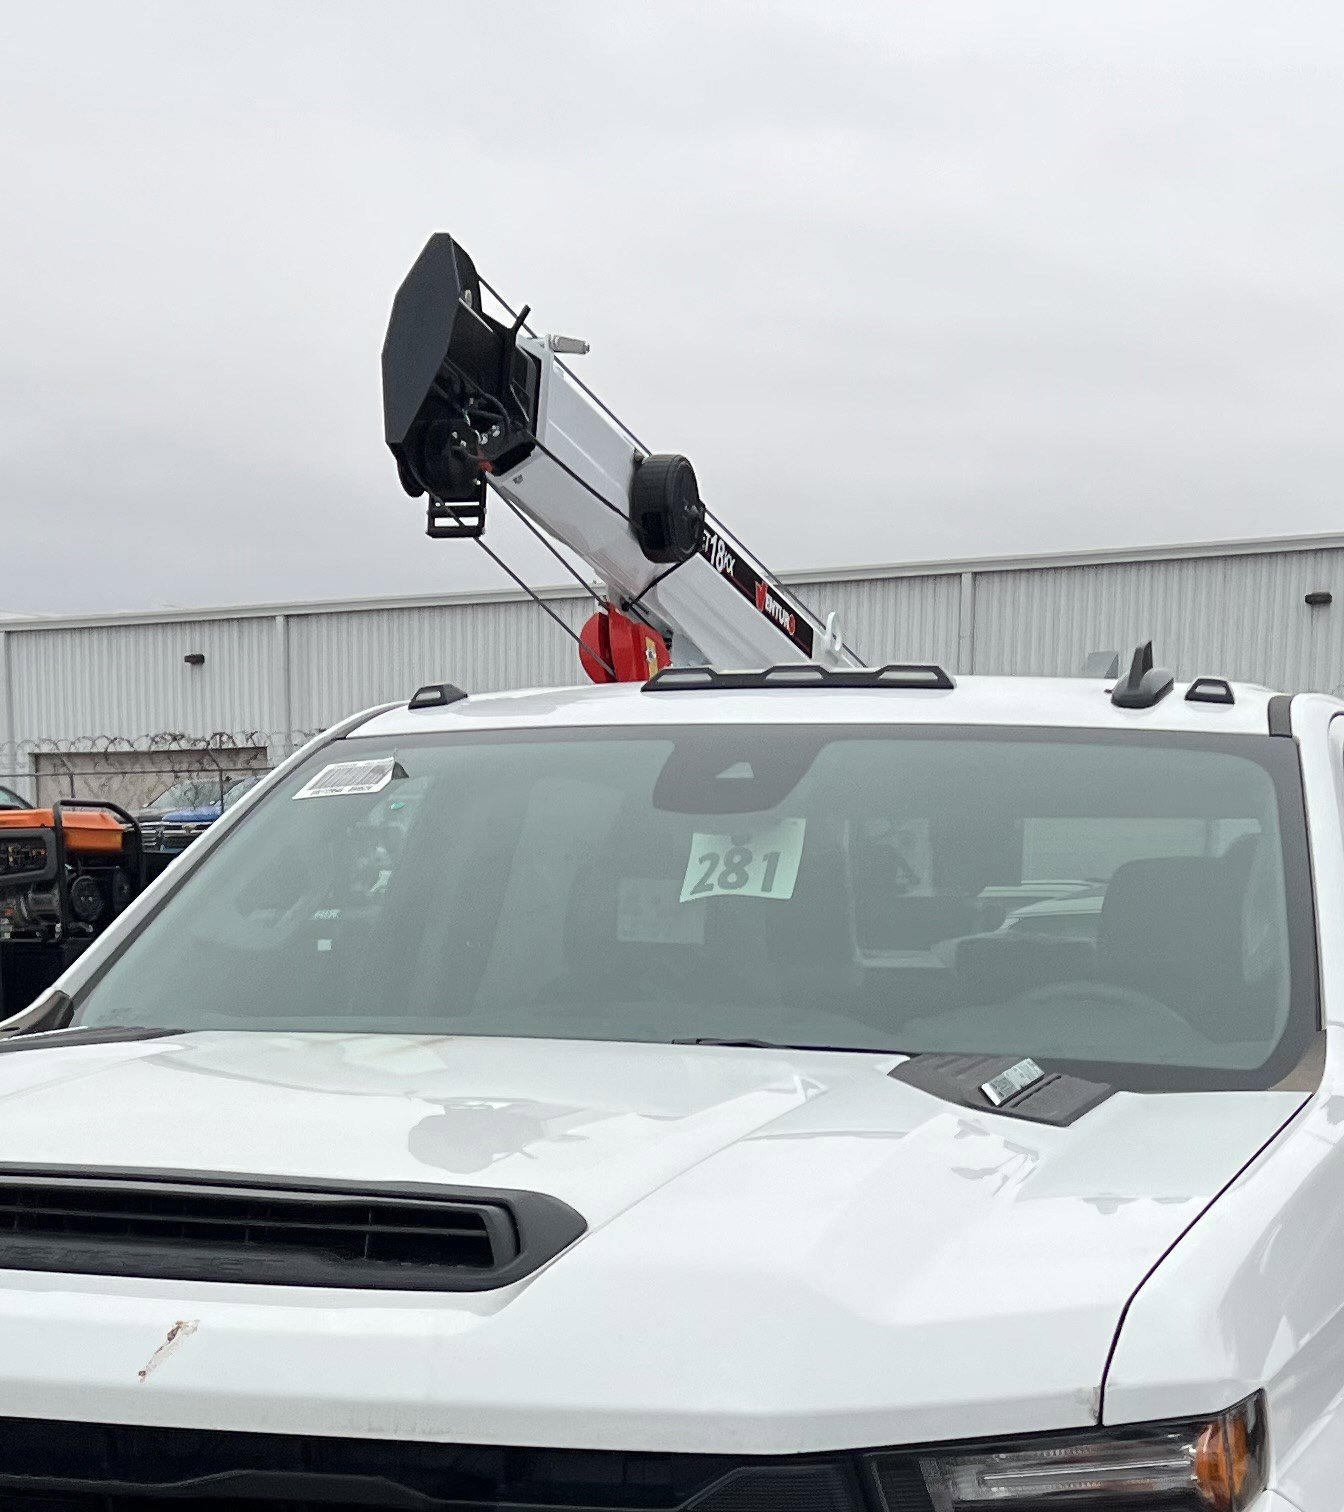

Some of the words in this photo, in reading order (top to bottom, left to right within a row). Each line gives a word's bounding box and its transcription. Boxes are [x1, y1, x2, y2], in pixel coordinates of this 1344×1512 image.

[702, 529, 736, 577] T18KX
[755, 580, 796, 635] VENTURO
[690, 847, 781, 895] 281
